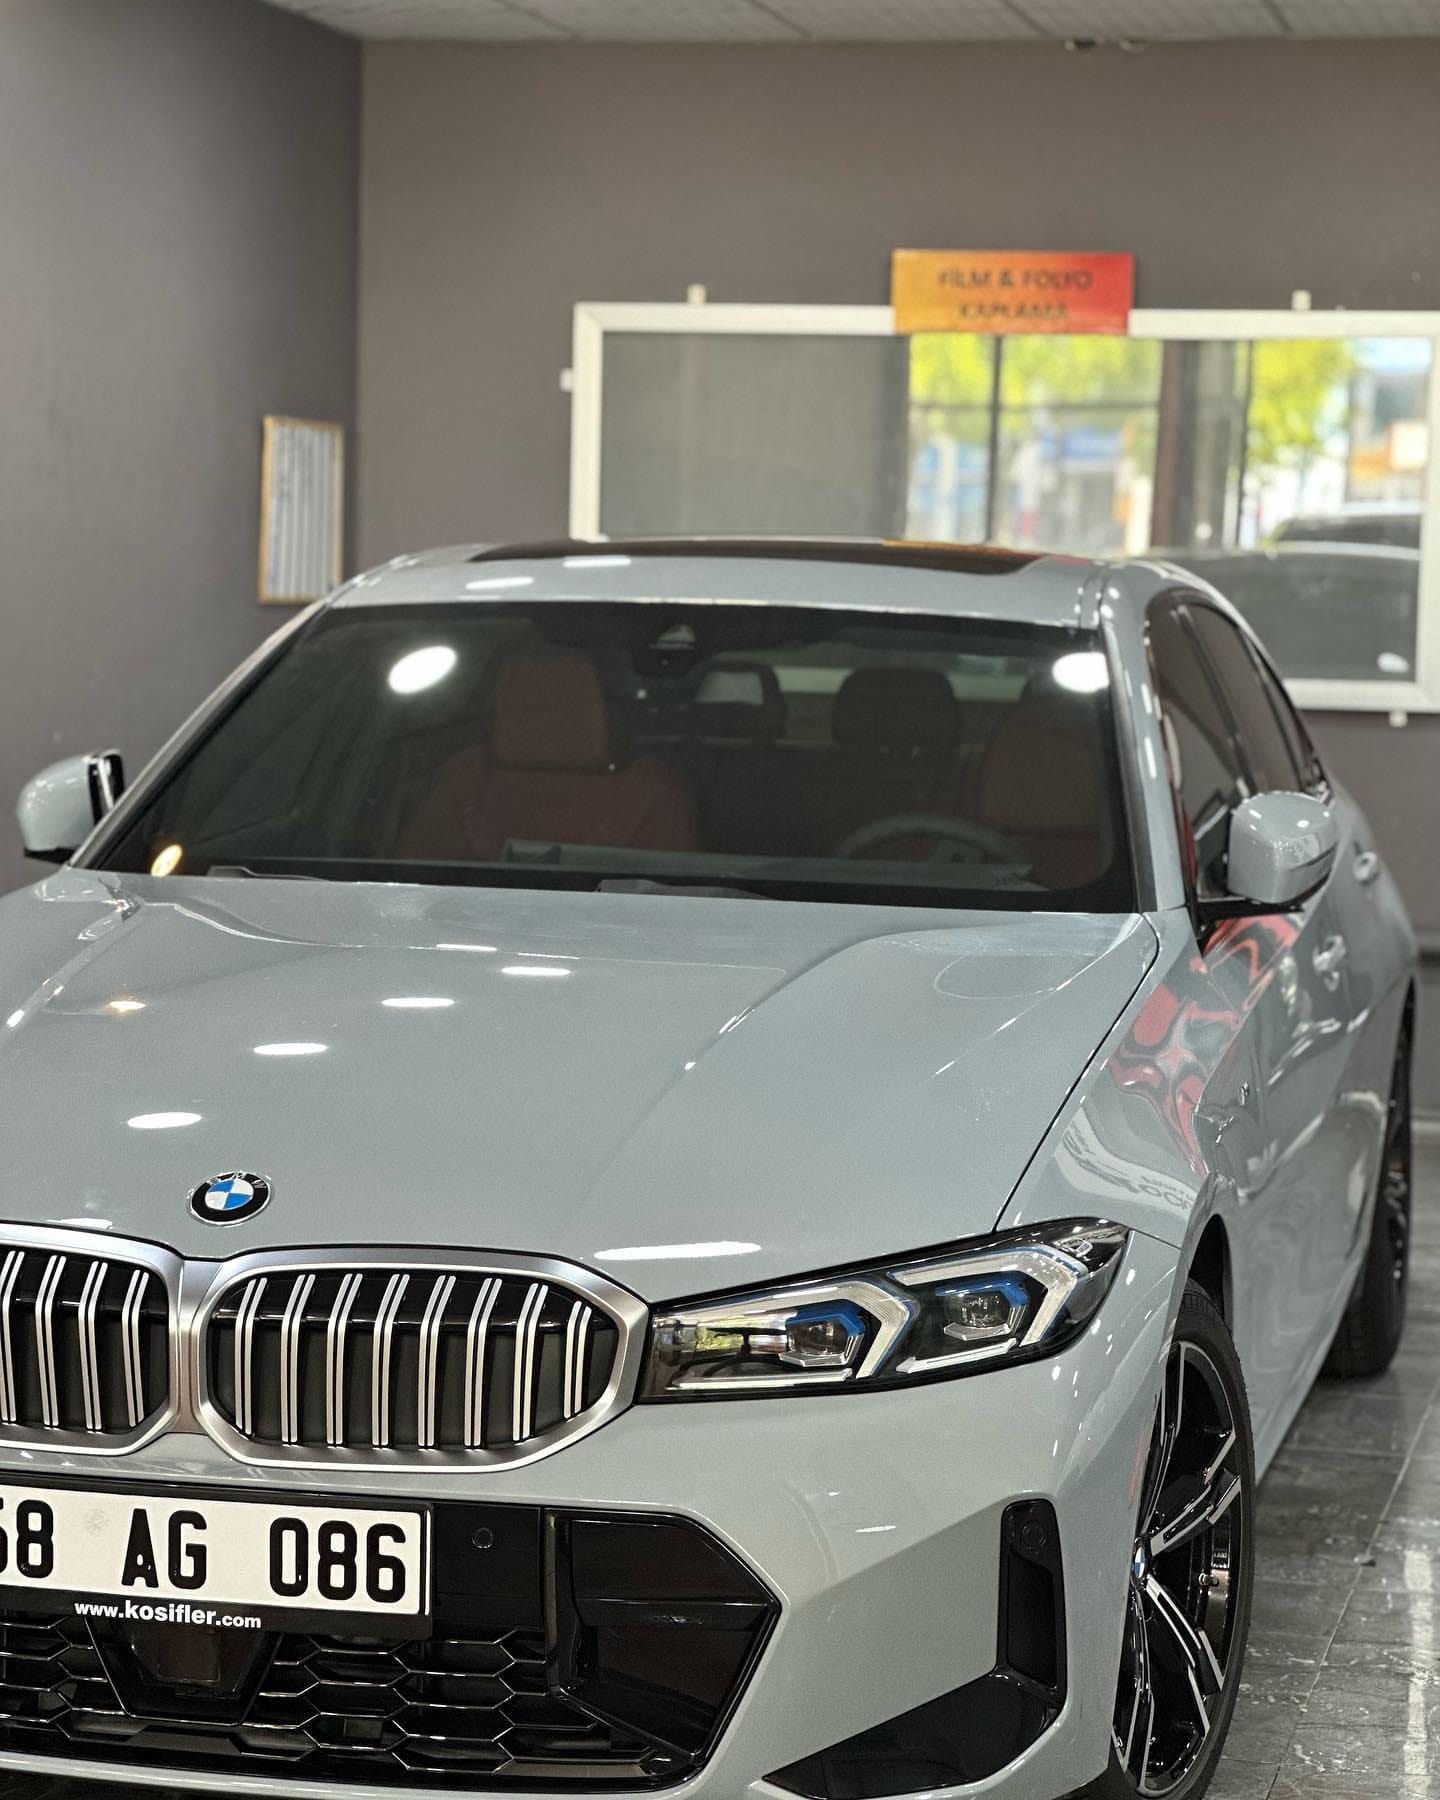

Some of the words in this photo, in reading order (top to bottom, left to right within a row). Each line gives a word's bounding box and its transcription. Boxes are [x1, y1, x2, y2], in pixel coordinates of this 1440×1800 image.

[999, 268, 1014, 289] &
[0, 1497, 54, 1578] 8
[121, 1508, 208, 1590] AG
[269, 1517, 407, 1603] 086
[74, 1600, 262, 1628] www.kosifler.com
